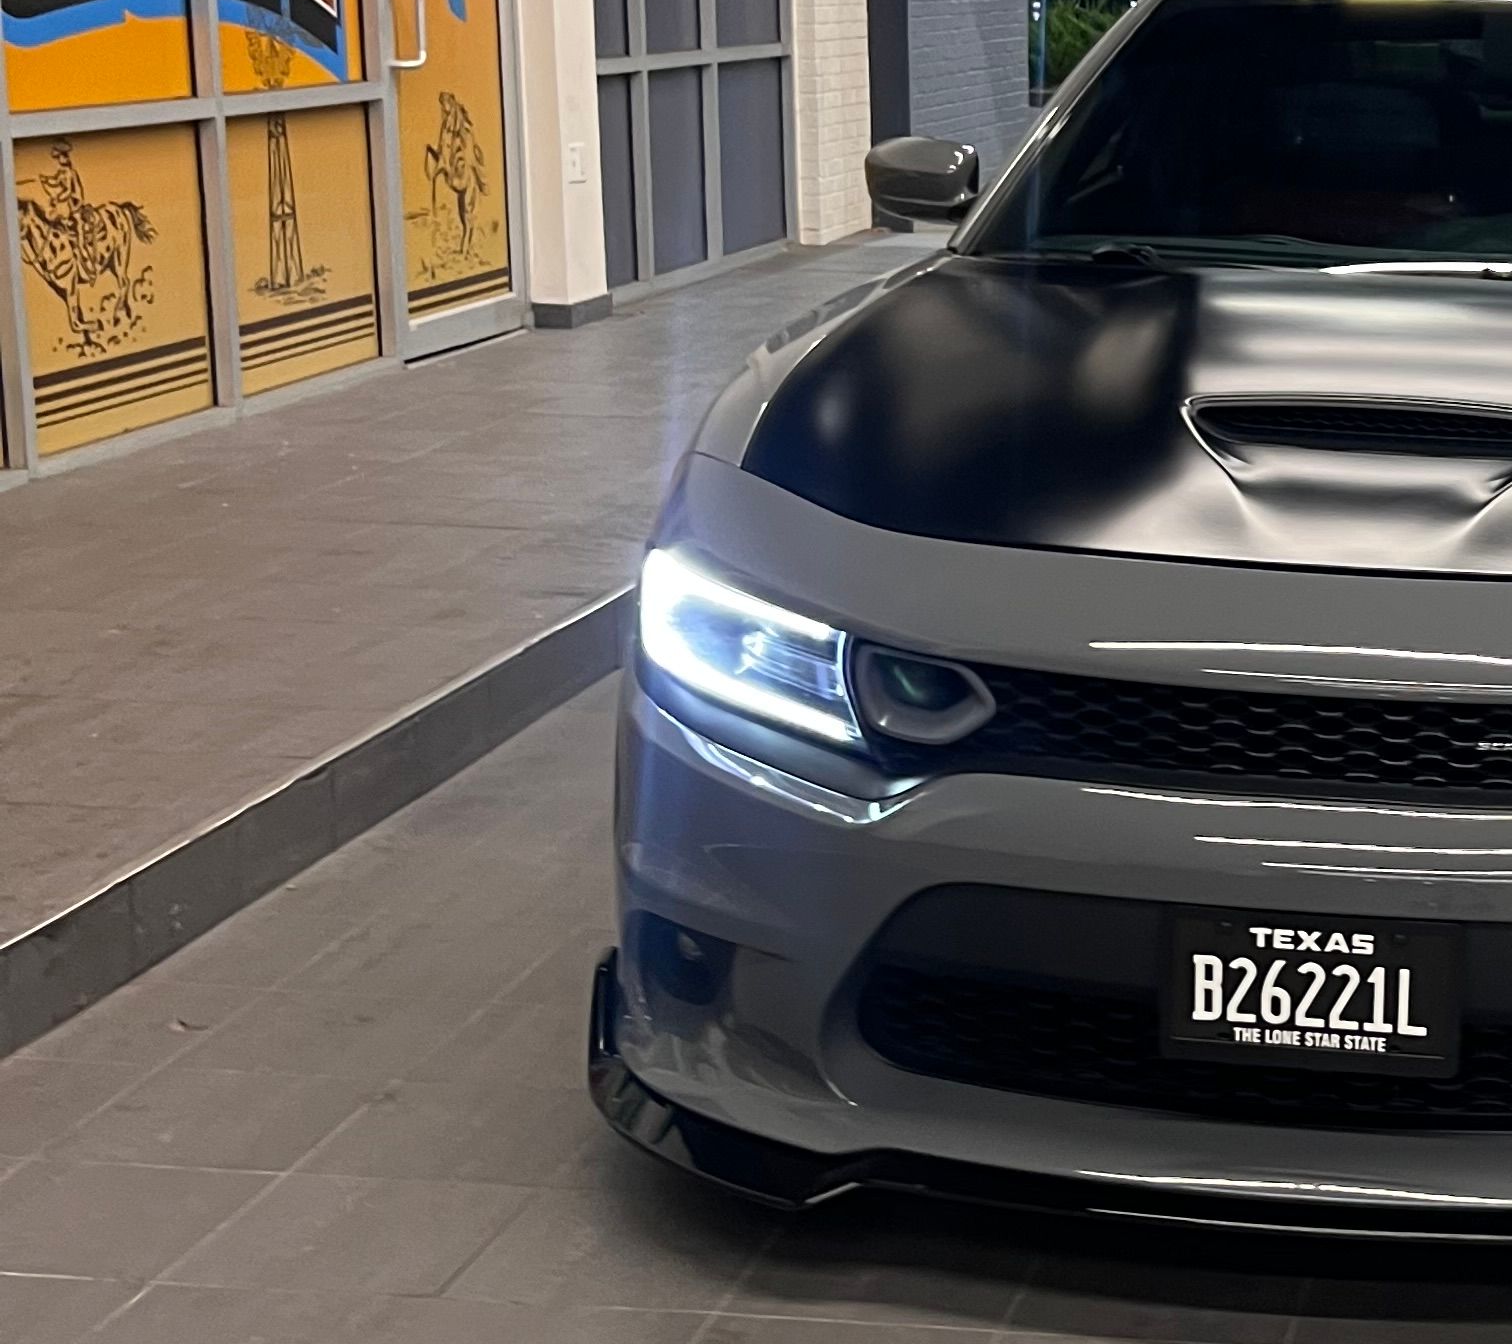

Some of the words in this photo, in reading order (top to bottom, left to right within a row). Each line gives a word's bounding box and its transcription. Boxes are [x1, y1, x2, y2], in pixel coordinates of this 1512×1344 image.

[1249, 927, 1374, 955] TEXAS
[1192, 954, 1427, 1036] B26221L
[1233, 1027, 1261, 1043] THE
[1265, 1029, 1300, 1046] LONE
[1304, 1032, 1340, 1049] STAR
[1344, 1035, 1387, 1052] STATE
